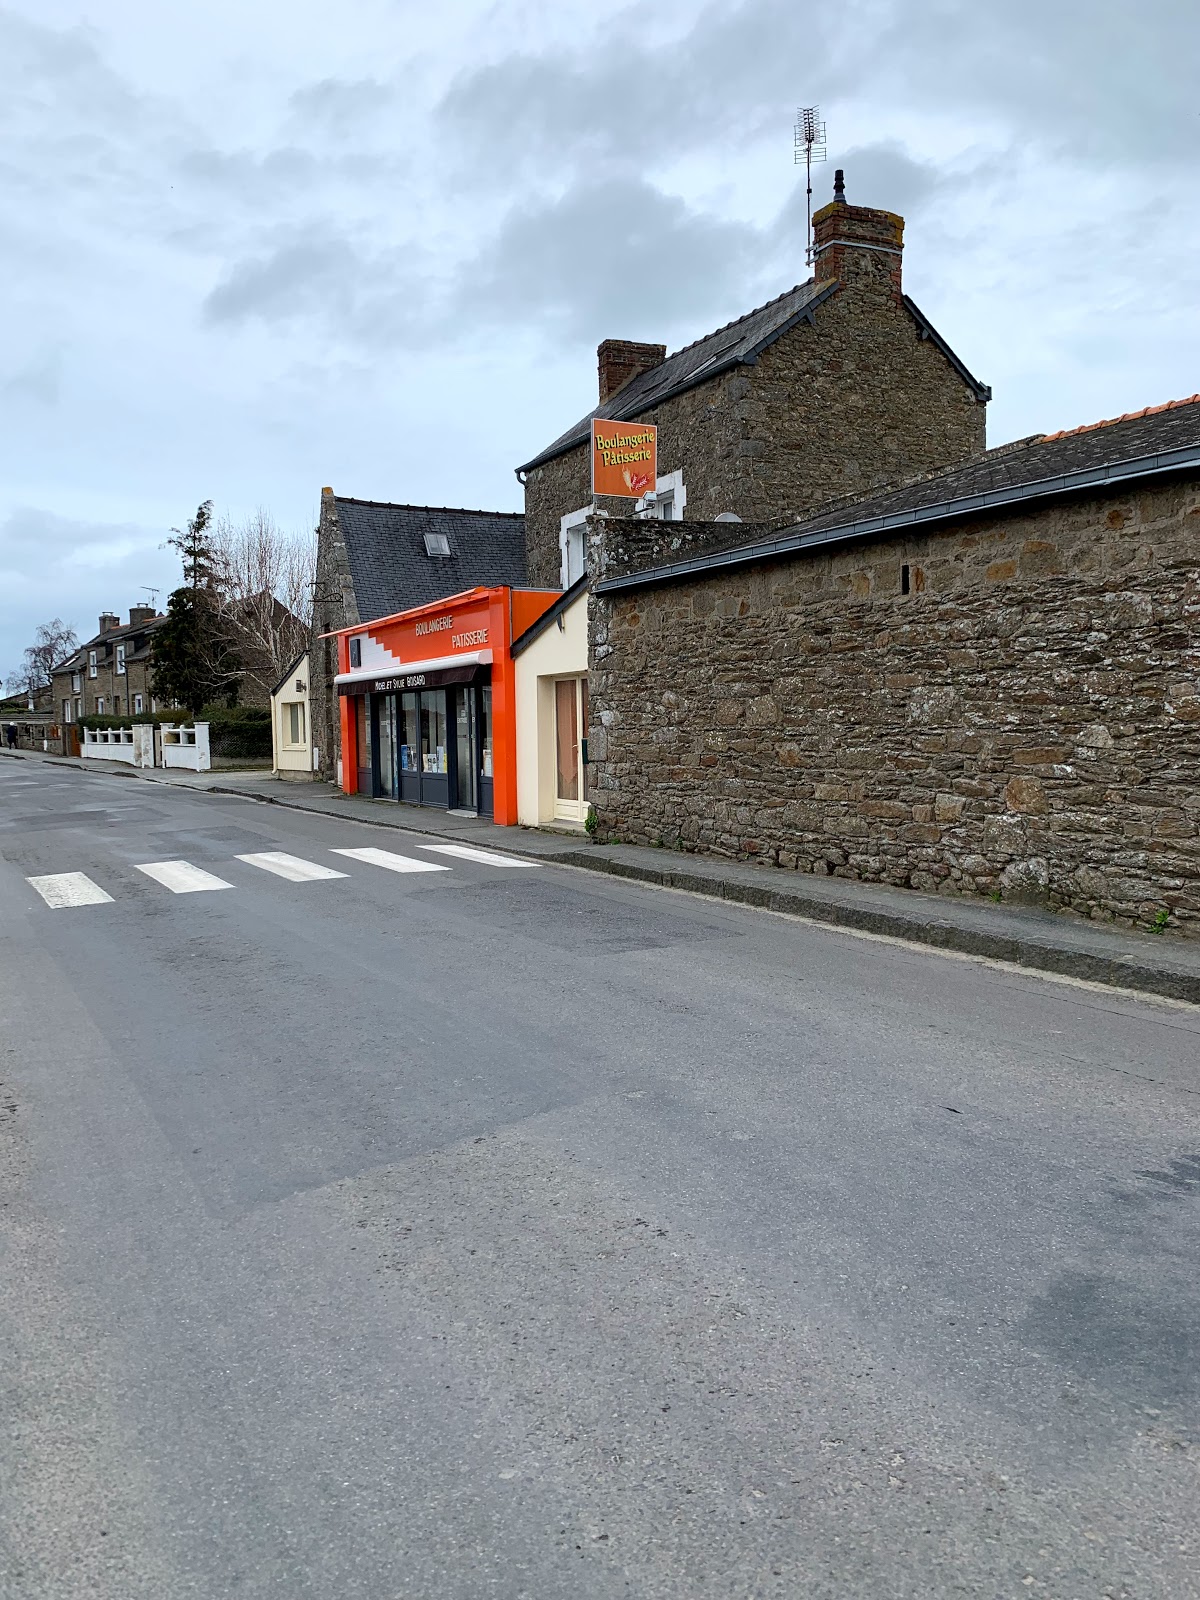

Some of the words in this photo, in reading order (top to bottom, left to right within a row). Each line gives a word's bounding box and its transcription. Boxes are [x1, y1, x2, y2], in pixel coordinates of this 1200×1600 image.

[595, 429, 655, 450] Boulangerie
[415, 615, 454, 636] BOULANGERIE
[451, 629, 489, 649] PATISSERIE
